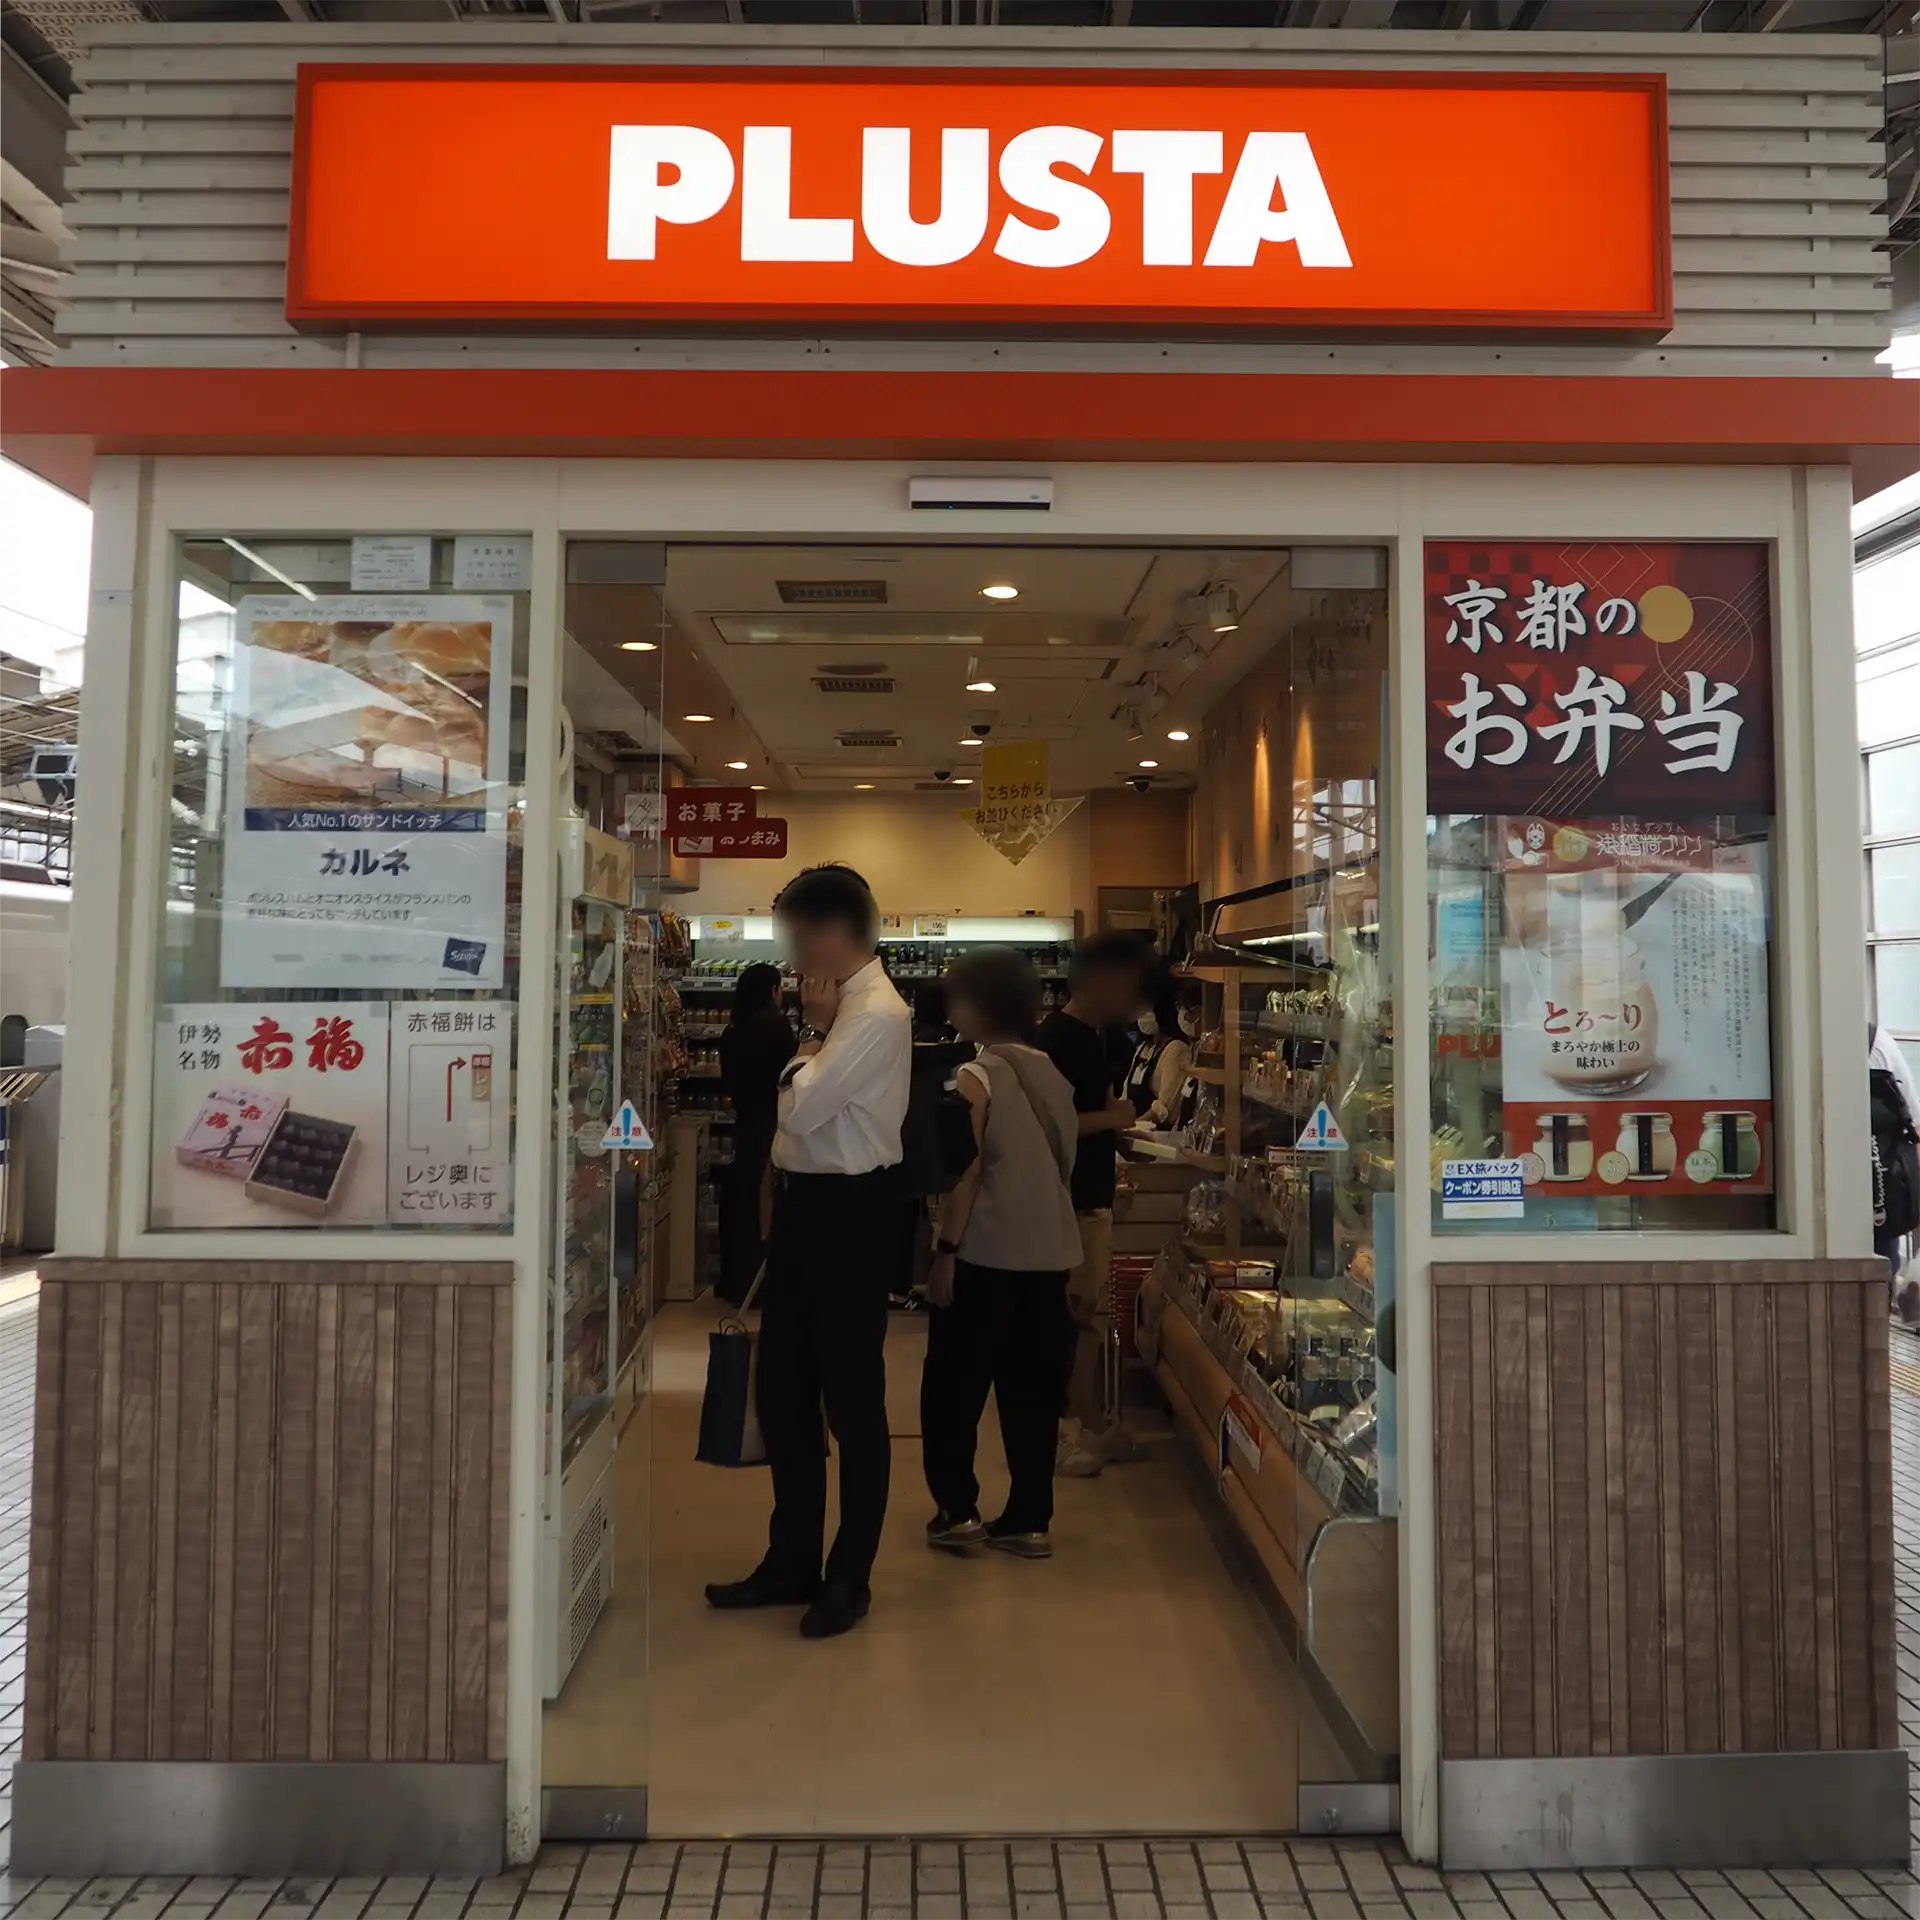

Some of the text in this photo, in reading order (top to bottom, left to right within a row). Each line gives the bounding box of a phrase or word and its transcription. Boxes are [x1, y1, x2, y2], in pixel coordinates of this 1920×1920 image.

[607, 125, 1353, 267] PLUSTA
[1443, 579, 1637, 653] 京都の
[1443, 666, 1745, 778] お弁当
[986, 781, 1045, 800] こちらから
[287, 813, 442, 828] 人気No.1のサンドイッチ
[677, 802, 746, 822] お菓子
[319, 848, 411, 876] カルネ
[407, 1012, 497, 1032] 赤福餅は
[177, 1023, 222, 1044] 伊勢
[236, 1016, 365, 1075] 赤福
[1550, 1039, 1641, 1055] まろやか極上の
[177, 1050, 222, 1070] 名物
[1576, 1056, 1616, 1071] 味わい
[405, 1165, 492, 1184] レジ奥に
[1457, 1162, 1520, 1175] EX旅パック
[1445, 1179, 1522, 1196] クーポン券引換店
[399, 1191, 498, 1210] ございます
